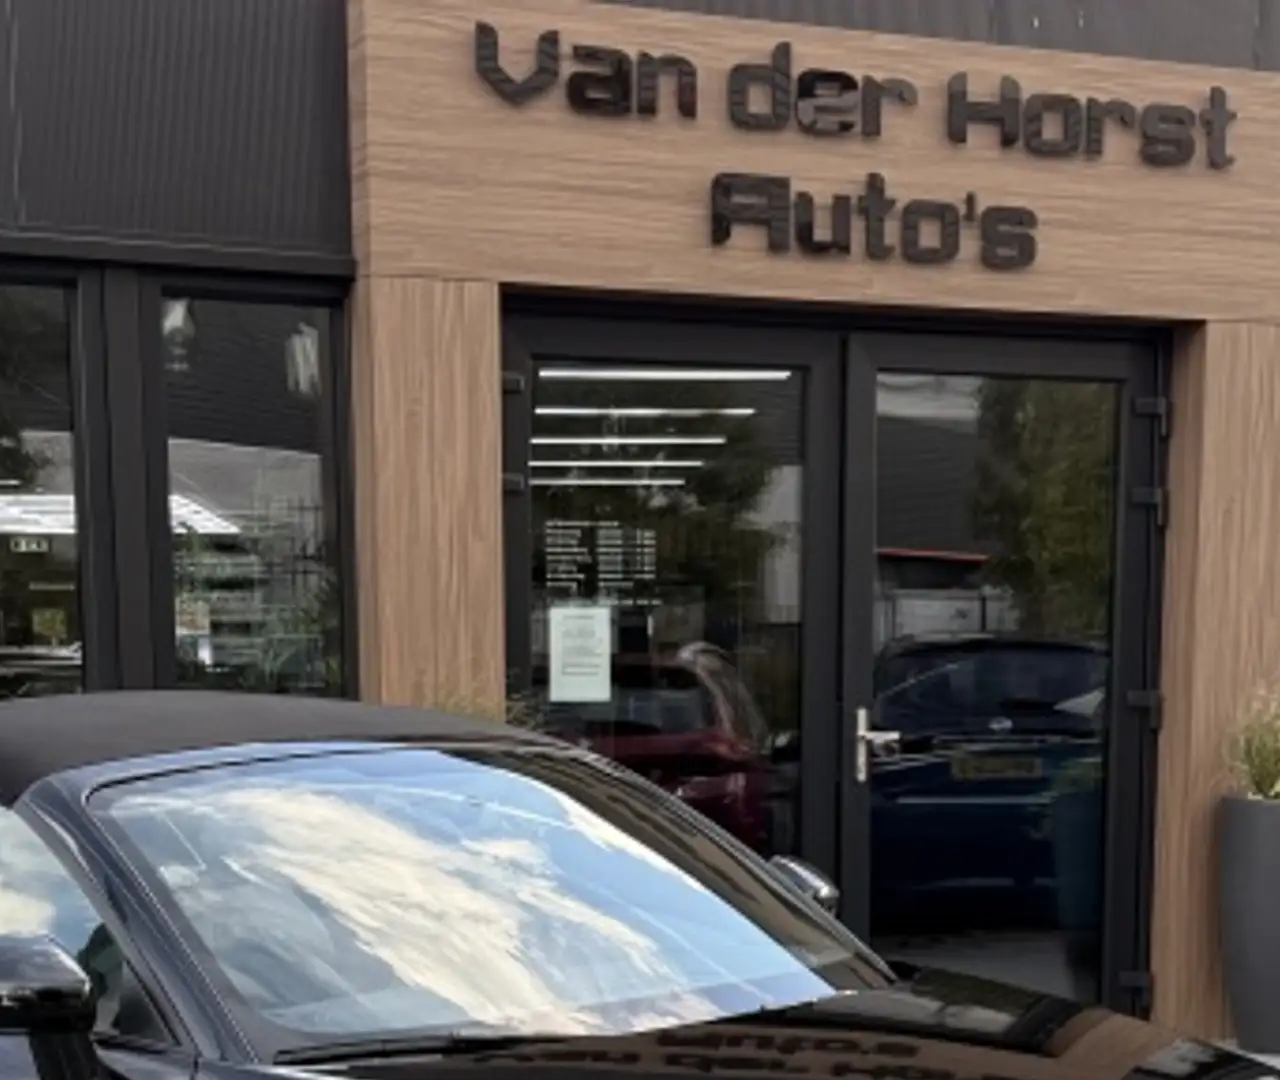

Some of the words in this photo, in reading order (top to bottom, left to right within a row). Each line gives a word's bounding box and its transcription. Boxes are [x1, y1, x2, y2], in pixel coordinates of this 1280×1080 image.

[474, 20, 698, 120] Van
[729, 41, 919, 138] der
[947, 71, 1238, 171] Horst
[710, 172, 1040, 270] Auto's
